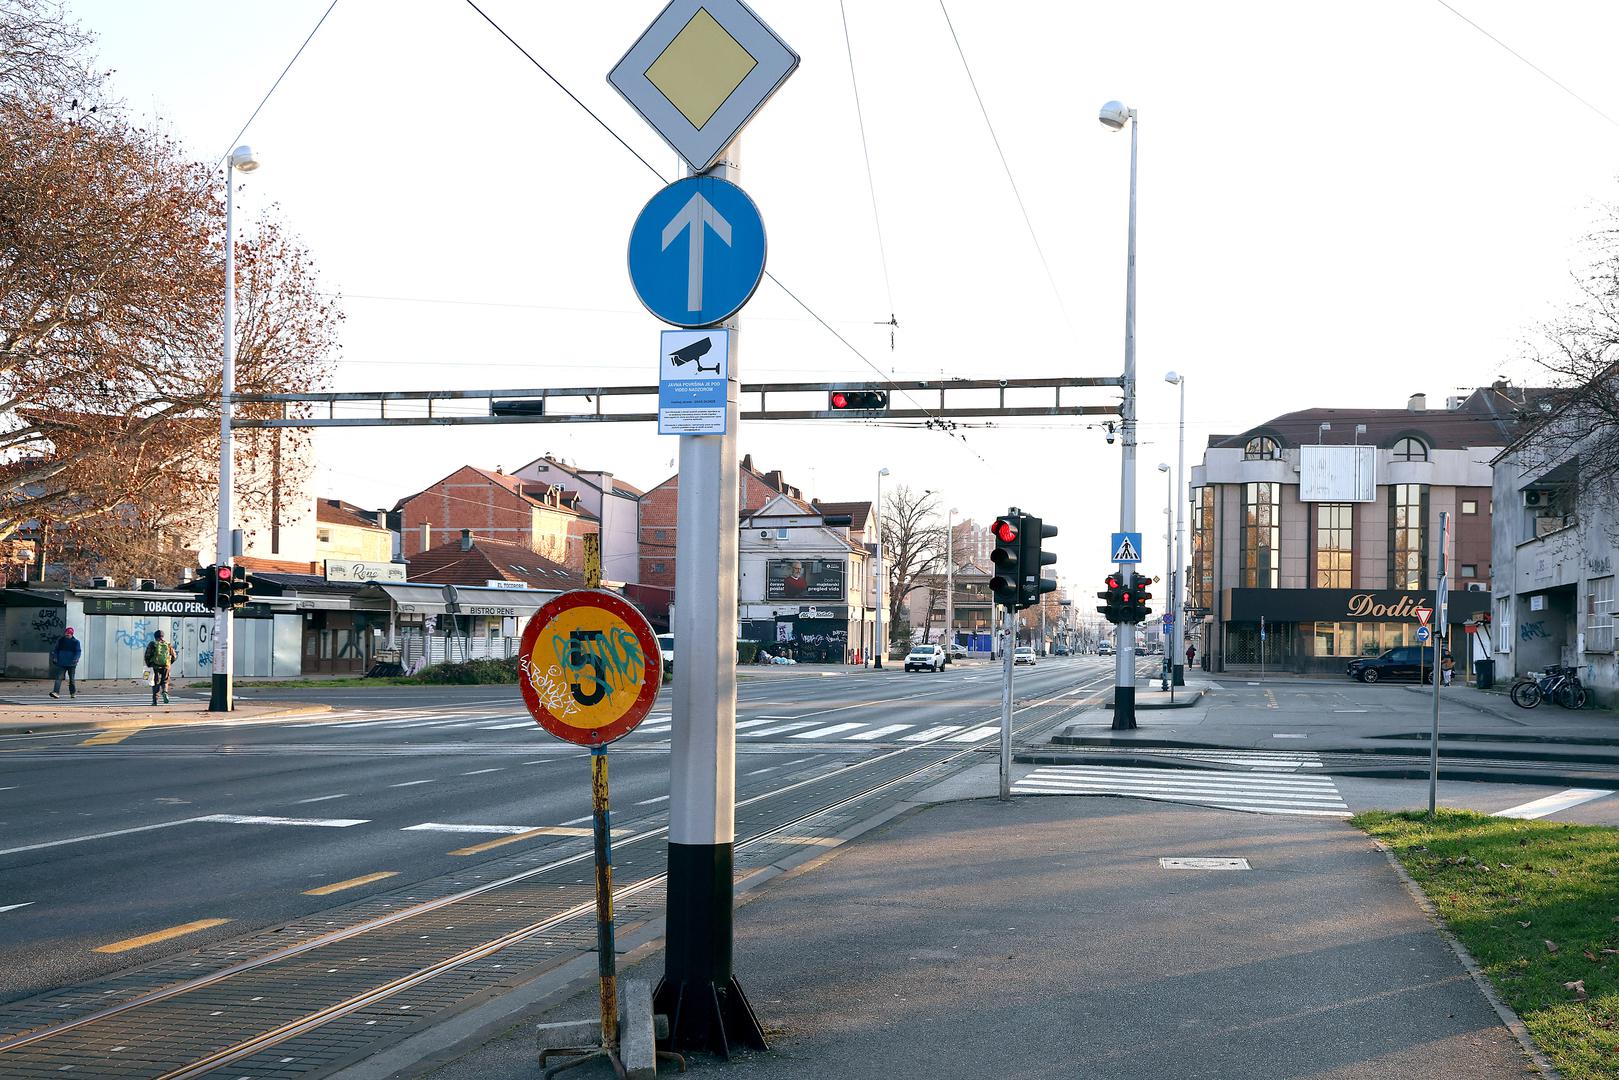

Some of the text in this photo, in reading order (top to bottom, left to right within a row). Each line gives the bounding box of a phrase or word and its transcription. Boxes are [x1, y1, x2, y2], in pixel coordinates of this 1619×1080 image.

[144, 600, 183, 612] TOBACCO
[1347, 593, 1427, 617] Dodić
[569, 630, 606, 706] 5
